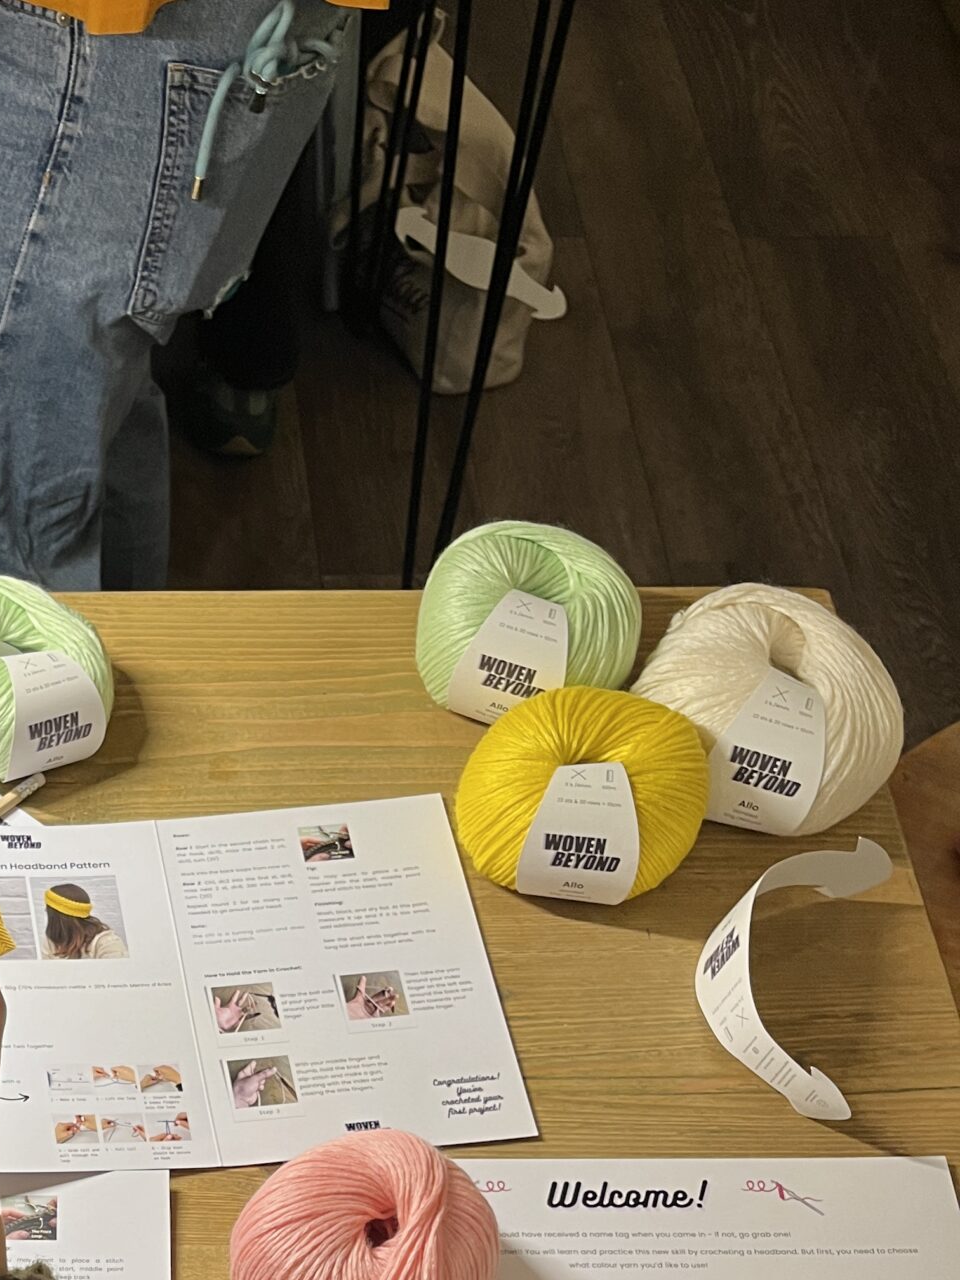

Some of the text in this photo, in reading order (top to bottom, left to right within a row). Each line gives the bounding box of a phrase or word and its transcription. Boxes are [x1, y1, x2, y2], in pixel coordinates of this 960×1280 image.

[479, 654, 537, 684] WOVEN
[28, 711, 79, 740] WOVEN
[37, 723, 92, 752] BEYOND
[730, 745, 792, 778] WOVEN
[732, 766, 802, 798] BEYOND
[0, 834, 32, 843] WOVEN
[544, 833, 607, 855] WOVEN
[10, 862, 68, 871] Headband
[70, 861, 111, 870] Pattern
[550, 851, 621, 873] BEYOND
[345, 1120, 381, 1131] WOVEN
[546, 1179, 708, 1209] Welcome!
